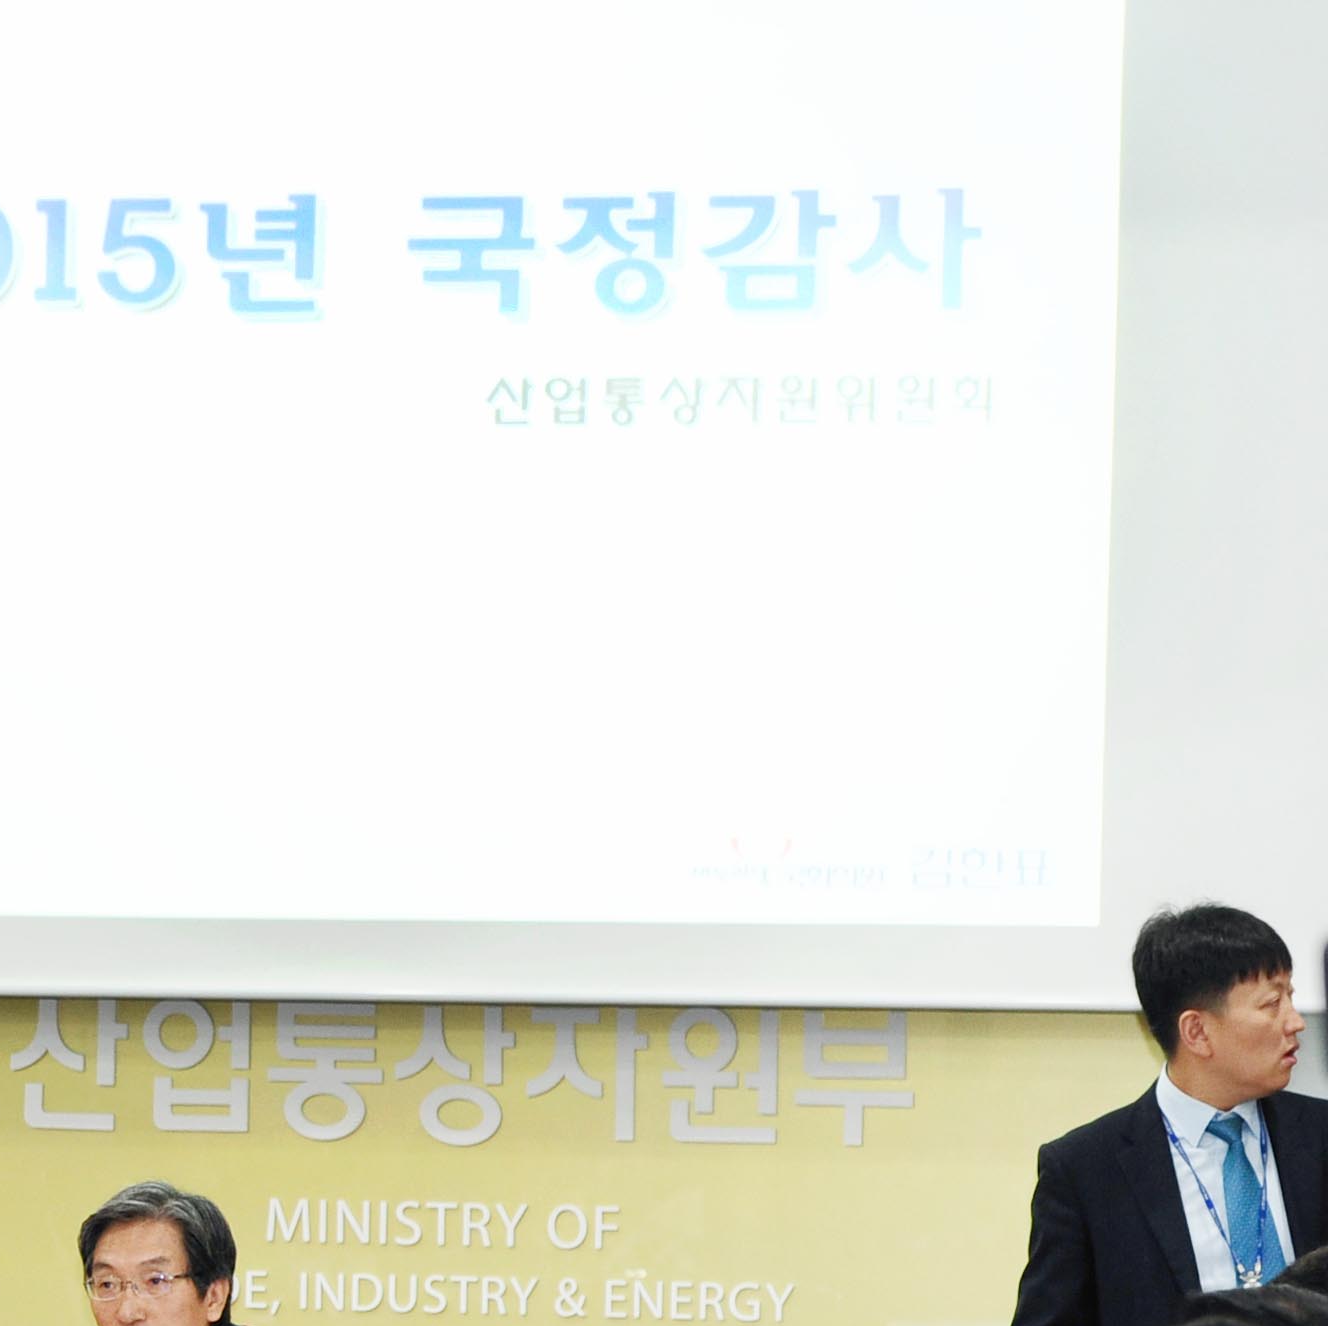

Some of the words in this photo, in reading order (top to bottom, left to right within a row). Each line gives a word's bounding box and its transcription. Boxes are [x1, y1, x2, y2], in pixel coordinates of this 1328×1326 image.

[406, 188, 984, 315] 국정감사
[484, 373, 996, 428] 산업통상자원위원회
[10, 998, 916, 1147] 산업통상자원부
[265, 1196, 532, 1249] MINISTRY
[547, 1203, 621, 1251] OF
[298, 1272, 541, 1316] INDUSTRY
[554, 1277, 587, 1319] &
[604, 1279, 795, 1323] ENERGY
